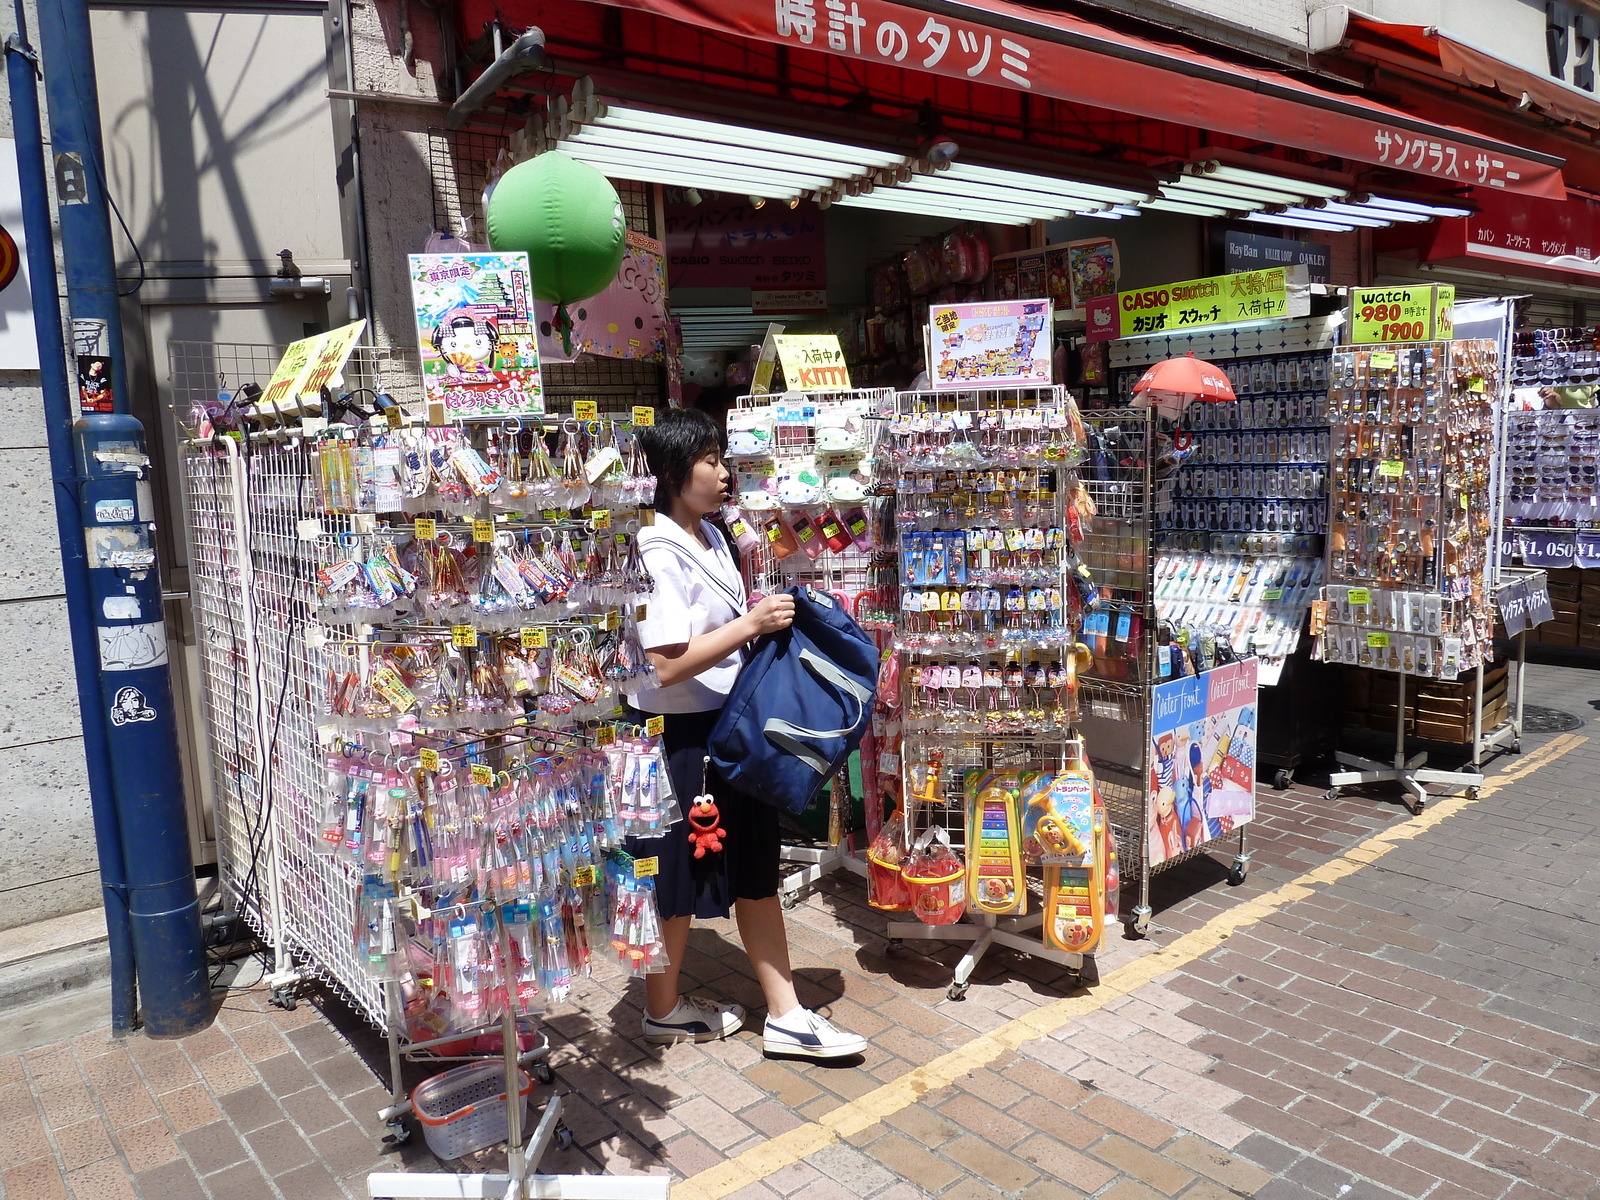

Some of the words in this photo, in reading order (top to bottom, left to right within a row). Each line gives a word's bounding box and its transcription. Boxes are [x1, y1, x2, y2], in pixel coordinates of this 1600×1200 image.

[775, 0, 1031, 88] 時計のタツミ
[1374, 129, 1520, 187] サングラス・サニー
[1477, 228, 1495, 242] カバン
[670, 256, 710, 265] CASIO
[772, 255, 812, 265] SEIKO
[1229, 242, 1258, 259] RayBan
[1299, 252, 1326, 267] OAKLEY
[429, 266, 471, 282] 東京限定
[1122, 289, 1170, 312] CASIO
[1171, 280, 1219, 302] swatch
[1230, 270, 1284, 298] 大特価
[1361, 290, 1411, 304] watch
[935, 311, 958, 327] ご当地
[1132, 312, 1168, 333] カシオ
[1178, 304, 1221, 325] スウォッチ
[1237, 297, 1285, 317] 入荷中!!
[1355, 304, 1402, 322] ¥980
[1404, 306, 1427, 317] 時計
[1373, 322, 1424, 341] ¥1900
[798, 366, 846, 387] KITTY
